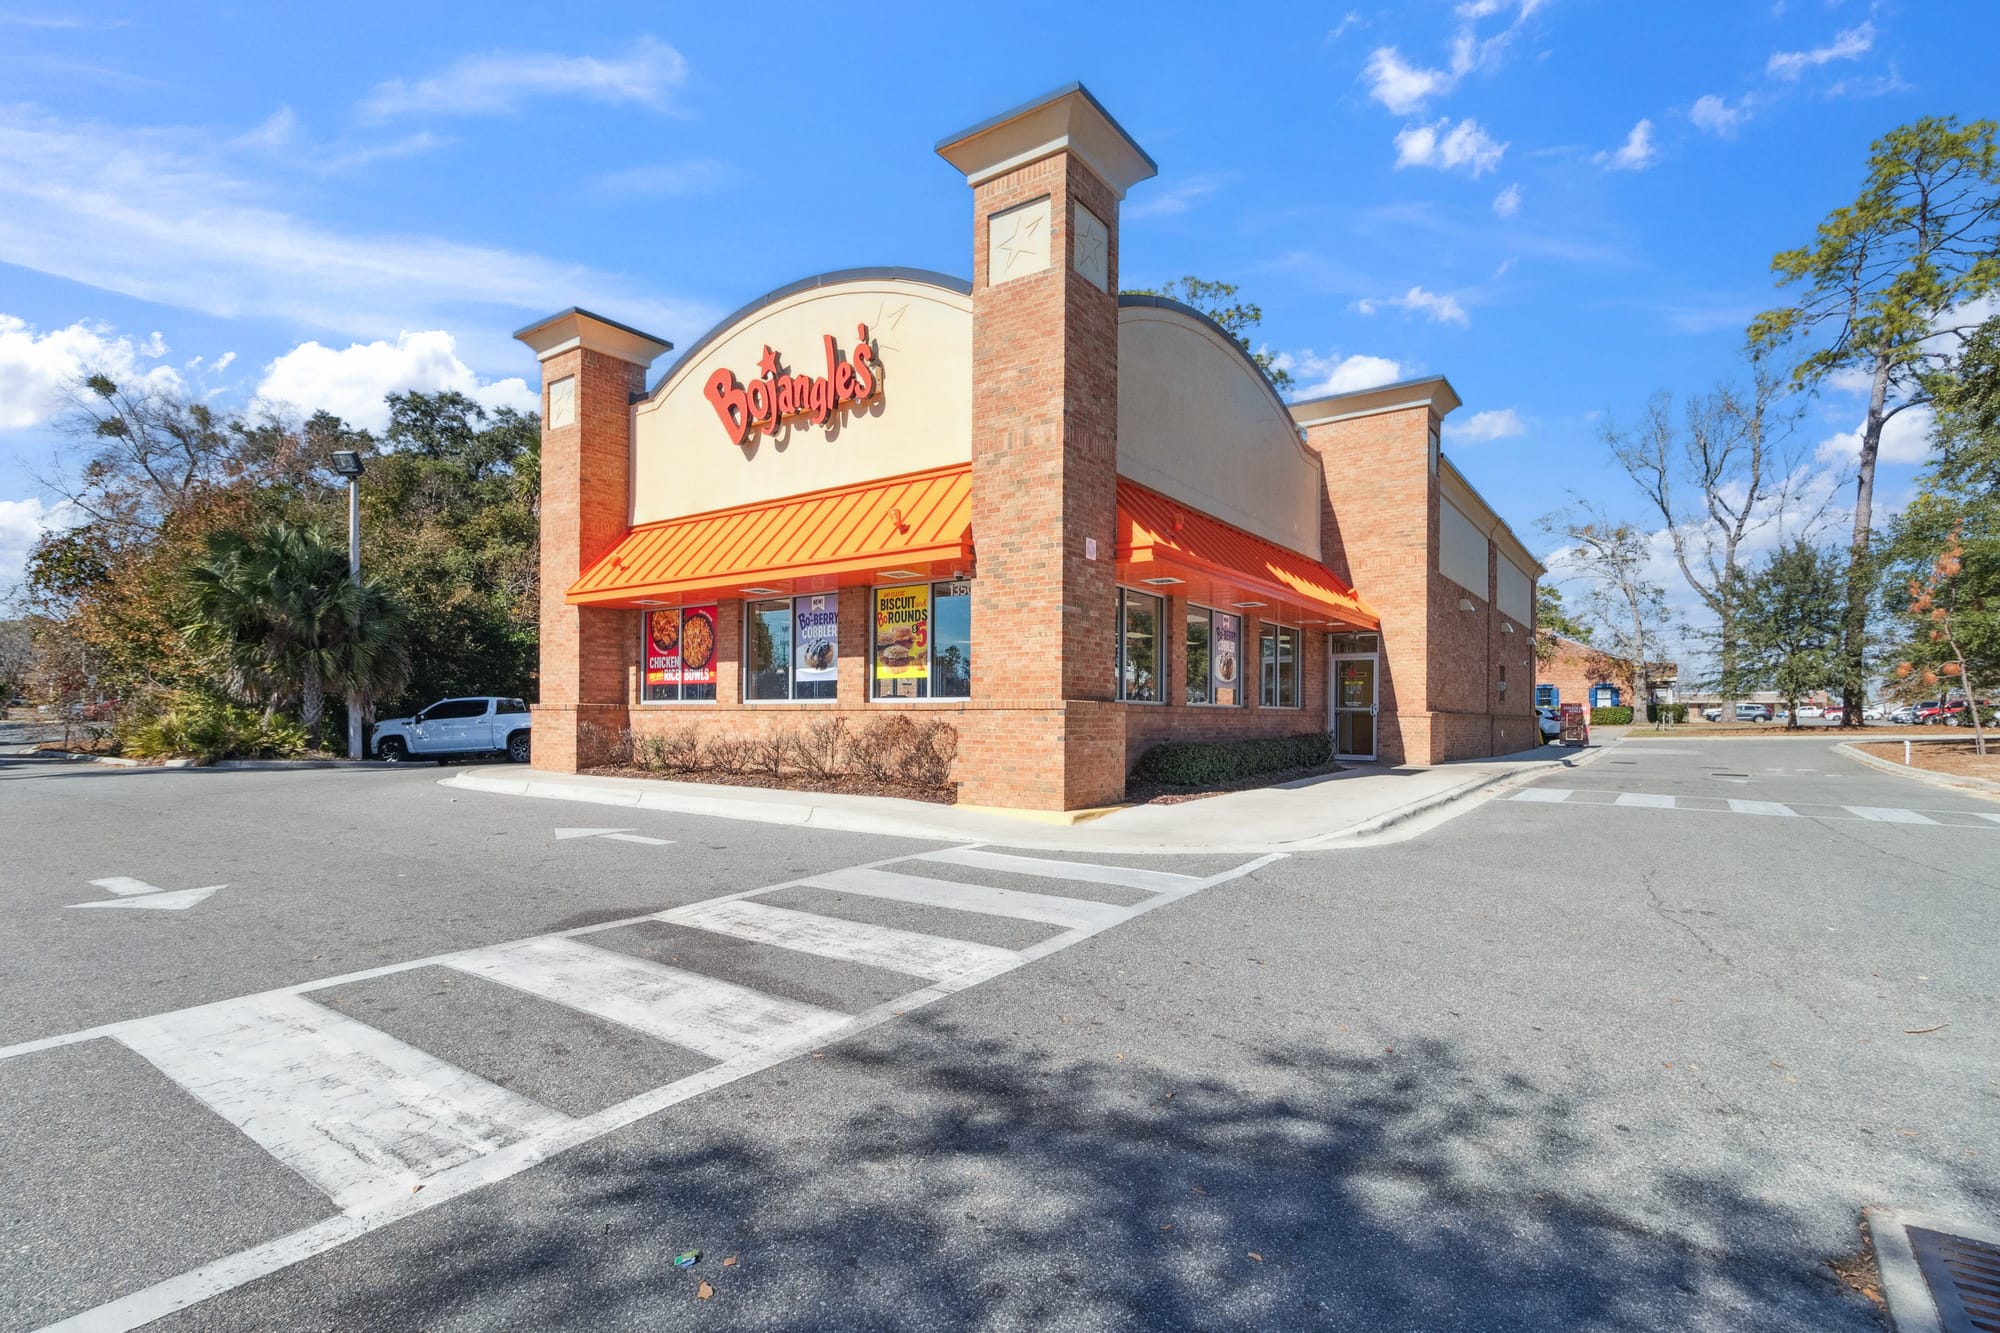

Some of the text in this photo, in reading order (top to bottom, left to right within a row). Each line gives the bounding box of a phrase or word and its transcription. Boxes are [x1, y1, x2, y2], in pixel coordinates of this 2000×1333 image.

[880, 596, 916, 611] BISCUIT
[802, 625, 837, 639] COBBLER
[650, 656, 680, 669] CHICKEN
[664, 668, 681, 681] RICE
[684, 668, 710, 681] BOWLS
